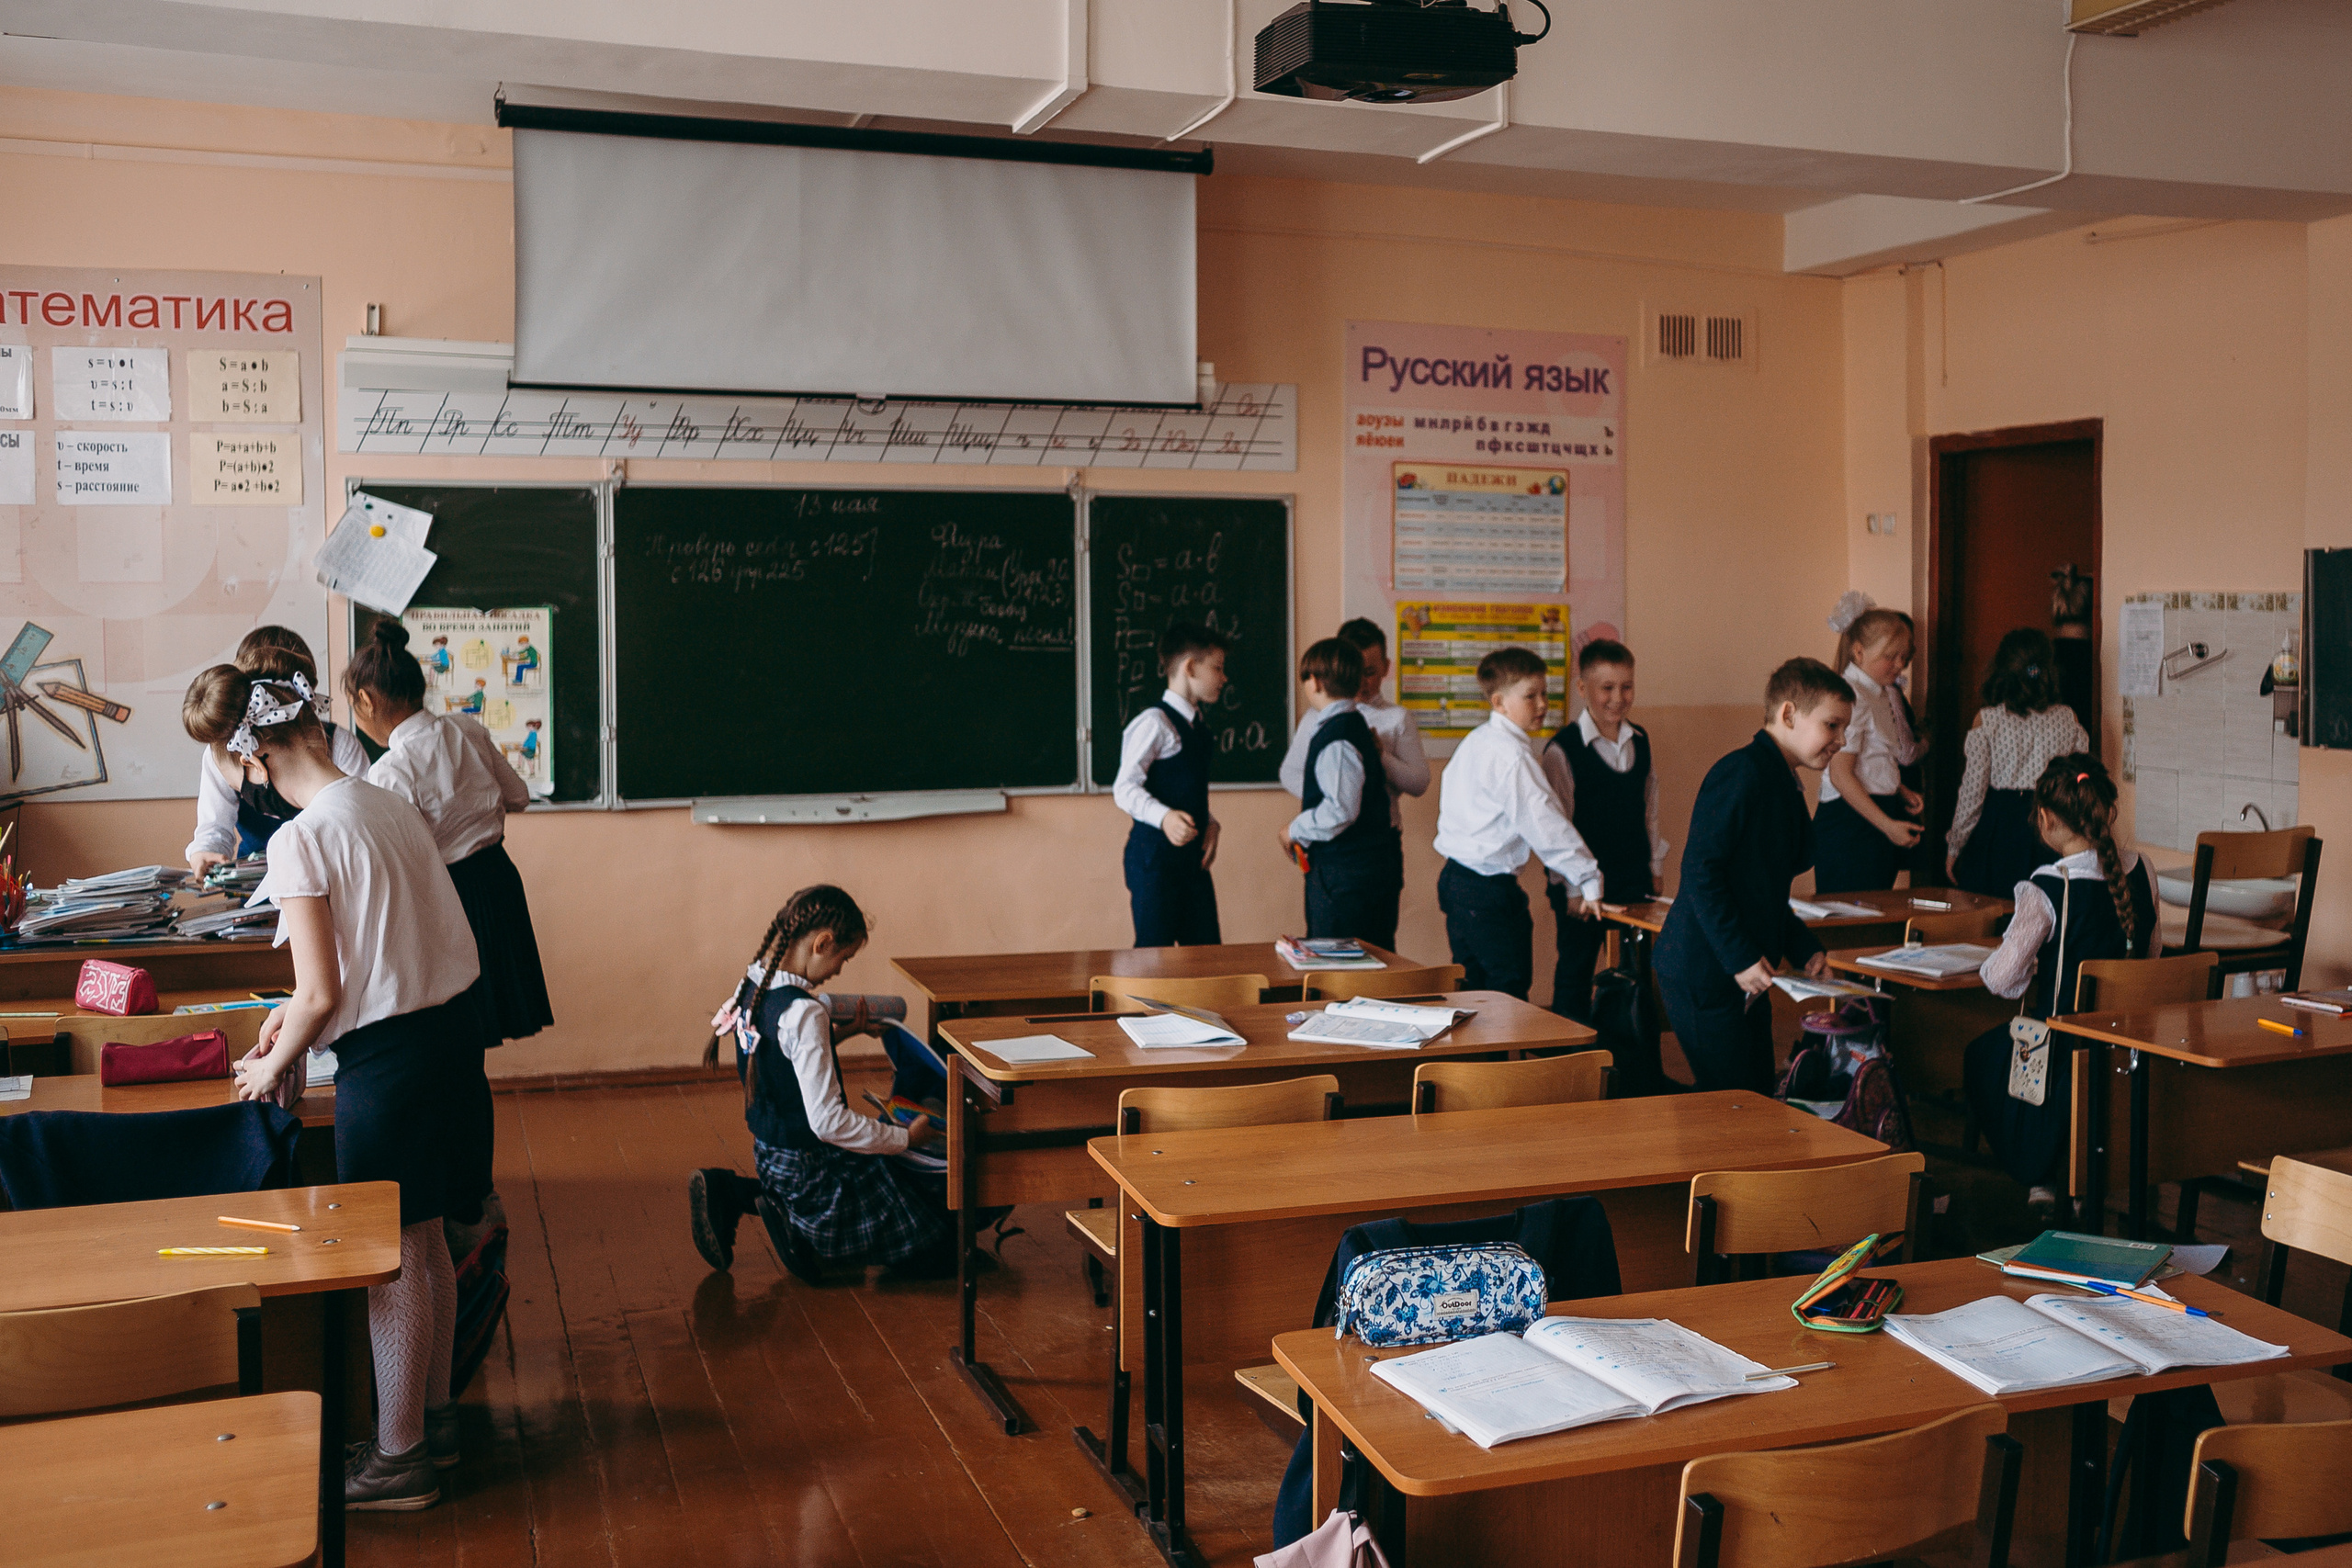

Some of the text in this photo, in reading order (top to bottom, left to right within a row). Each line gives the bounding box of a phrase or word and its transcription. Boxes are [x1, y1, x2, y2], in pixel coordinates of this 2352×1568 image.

[0, 290, 294, 333] тематика
[1362, 345, 1611, 394] Русский язык
[76, 441, 129, 454] скорость
[74, 462, 109, 476] время
[1445, 471, 1517, 487] ПАДЕЖИ
[75, 480, 140, 494] расстояние
[439, 622, 476, 633] ВРЕМЯ
